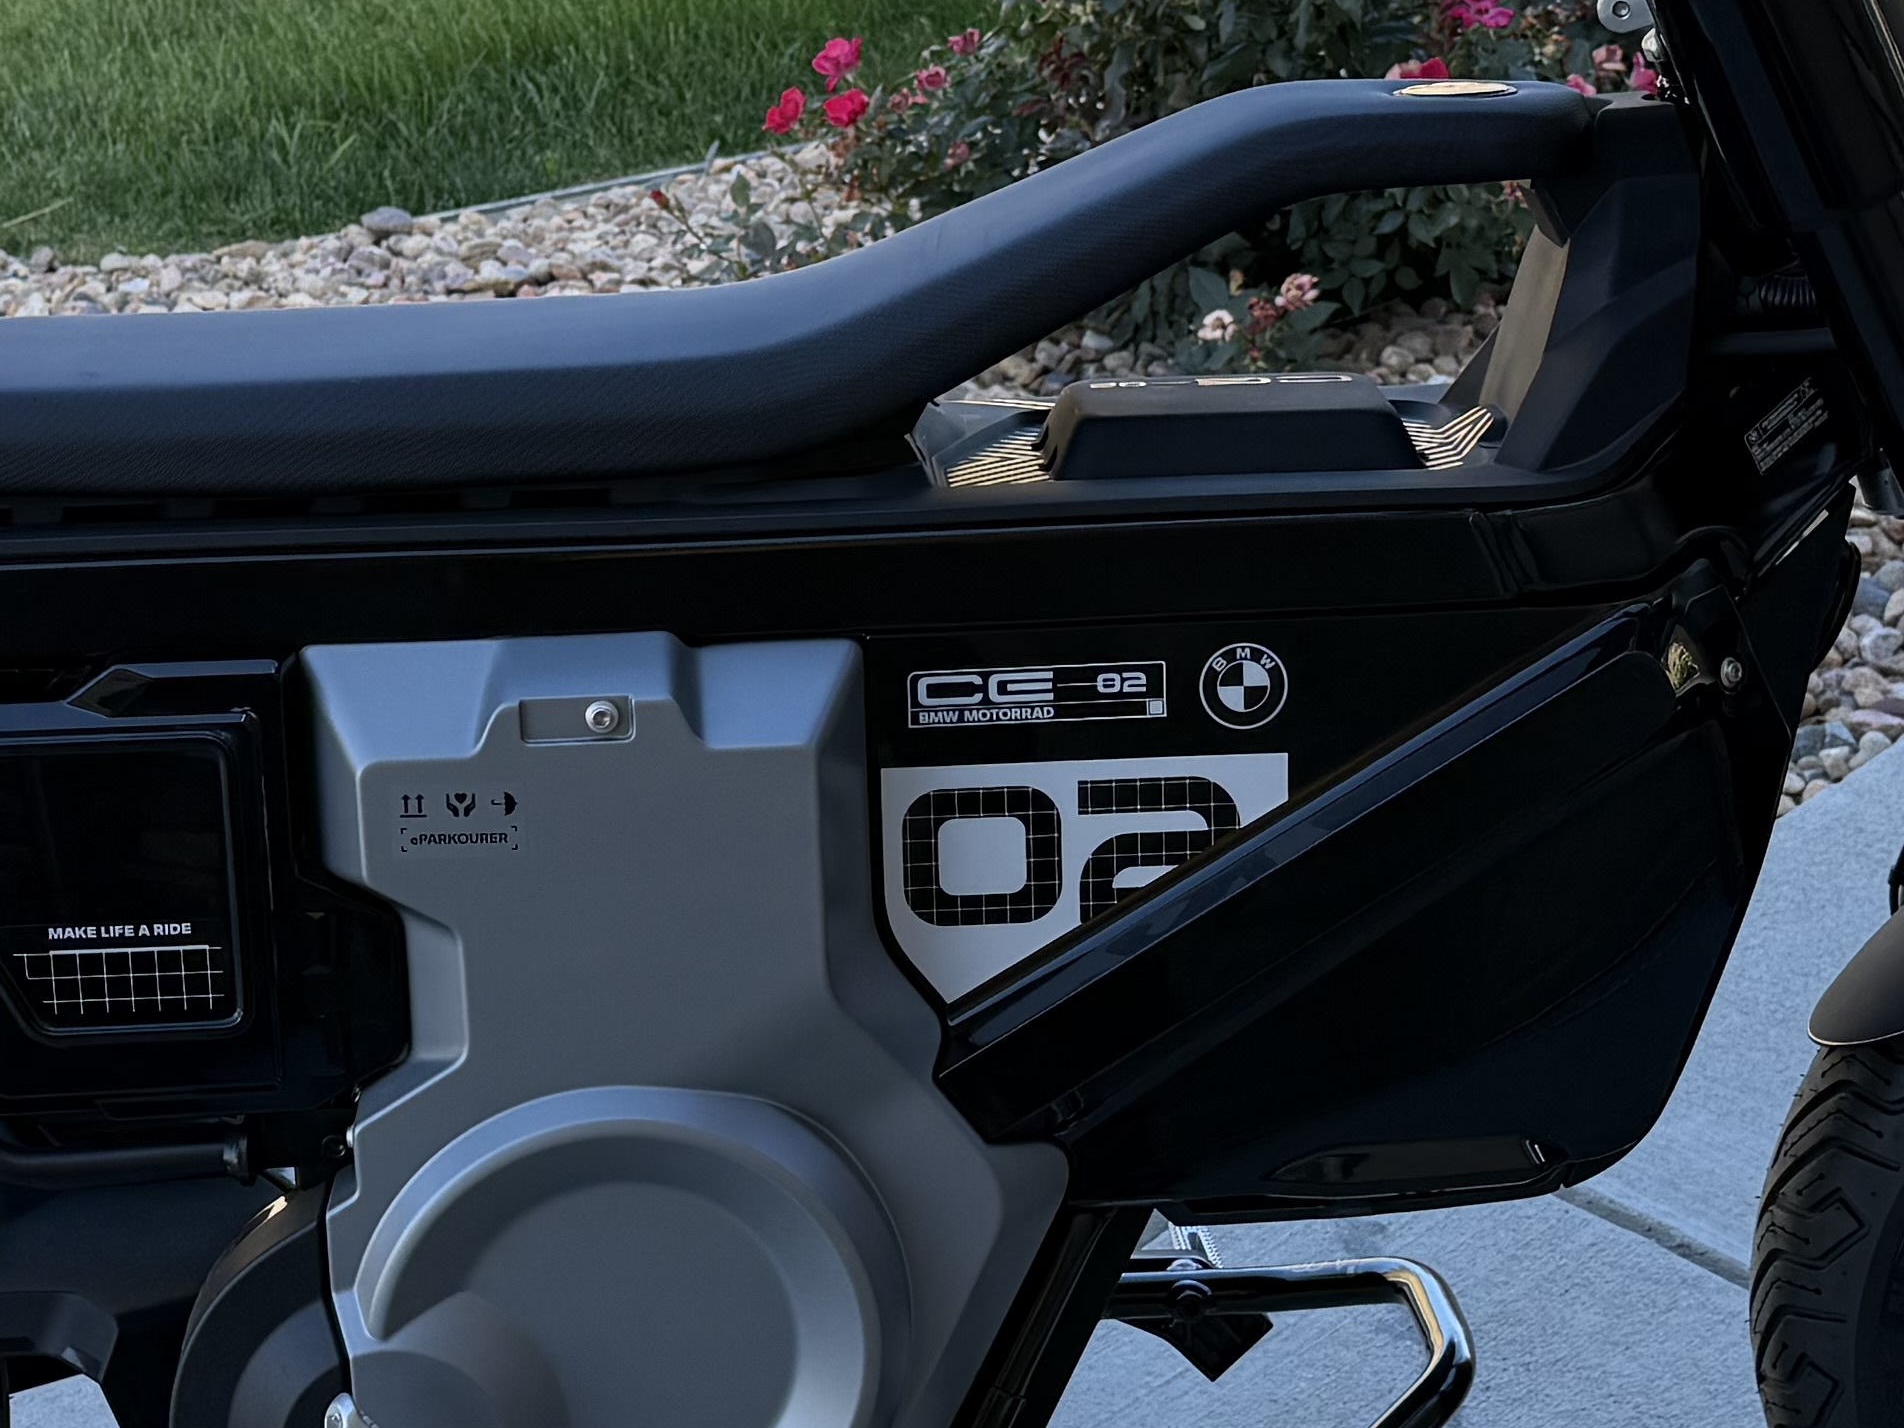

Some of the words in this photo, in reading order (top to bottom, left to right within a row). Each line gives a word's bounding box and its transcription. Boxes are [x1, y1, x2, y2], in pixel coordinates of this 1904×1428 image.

[1212, 647, 1276, 672] BMW
[917, 671, 1054, 706] CE
[919, 710, 959, 723] BMW
[964, 706, 1054, 721] MOTORRAD
[48, 926, 97, 940] MAKE
[100, 925, 135, 937] LIFE
[138, 924, 151, 936] A
[153, 923, 192, 936] RIDE
